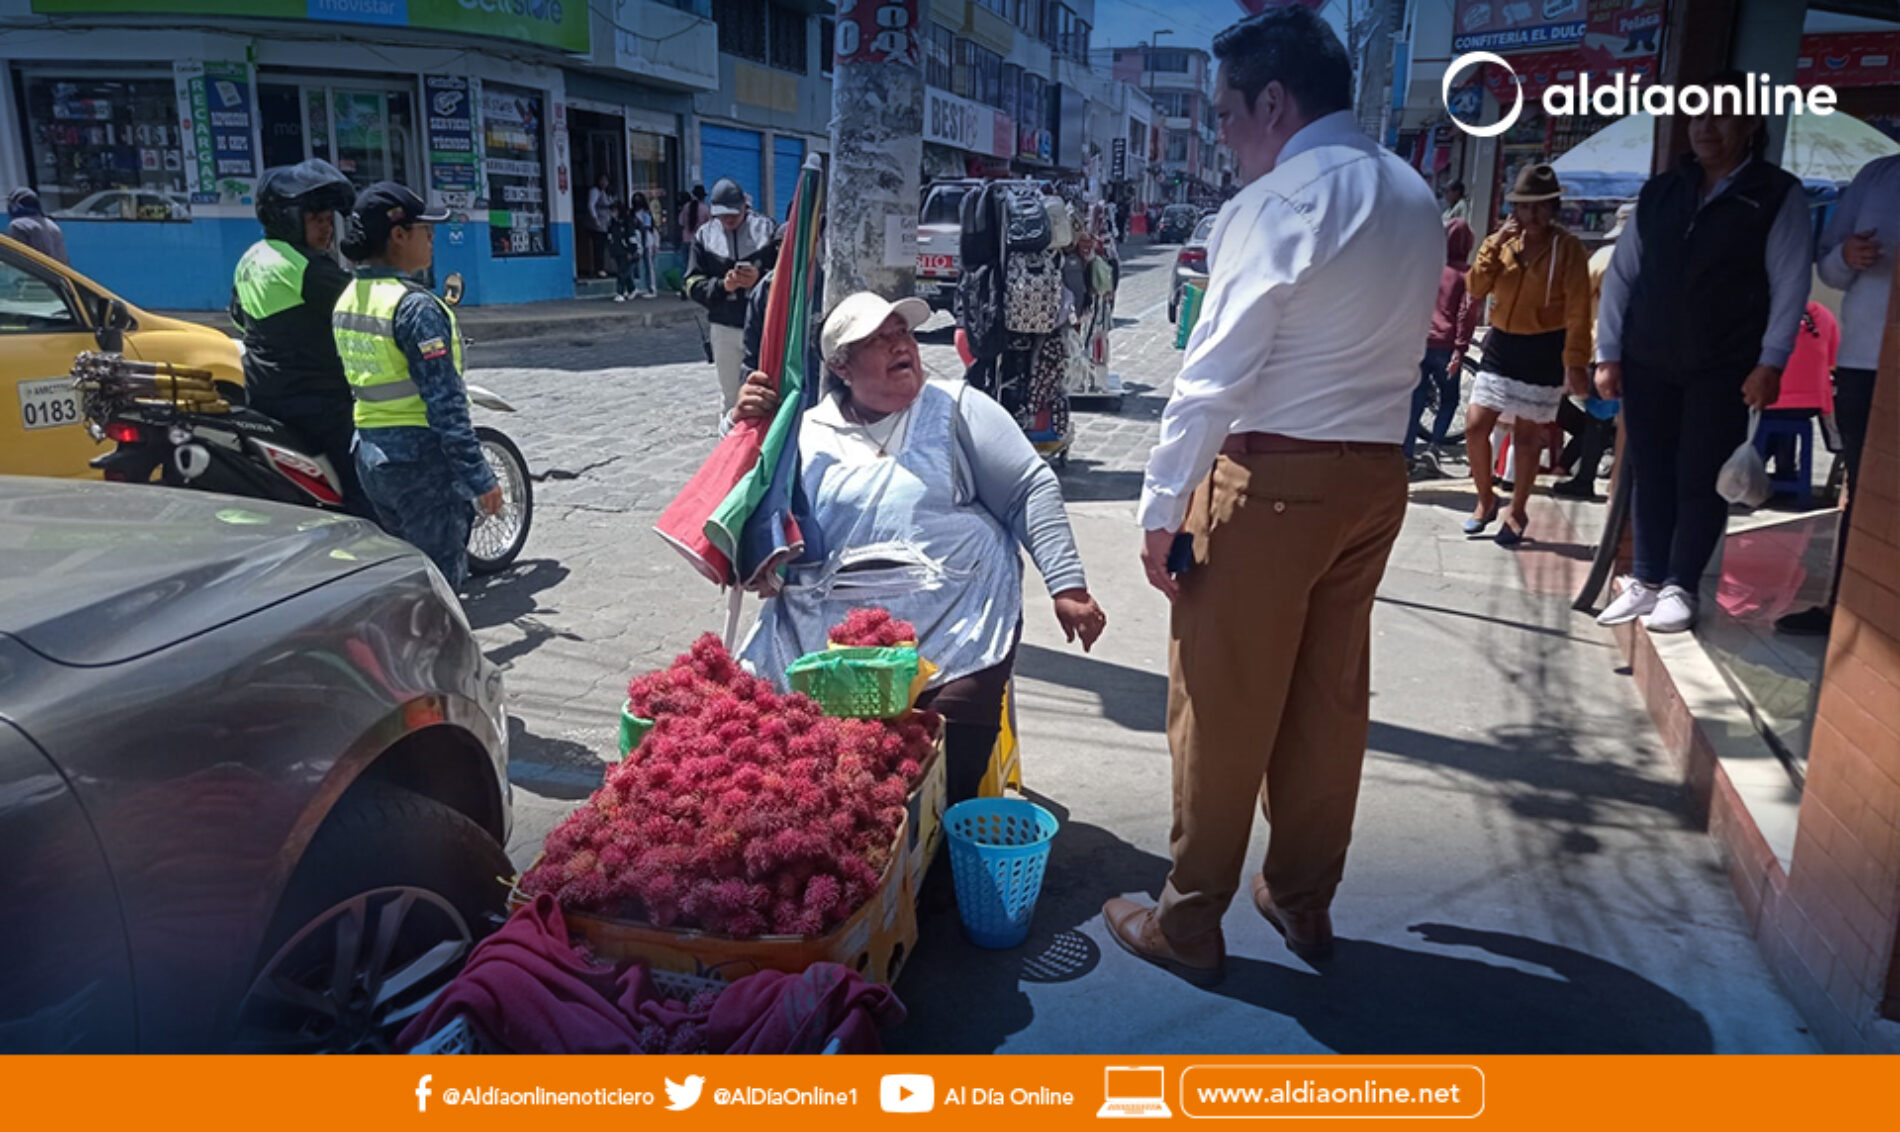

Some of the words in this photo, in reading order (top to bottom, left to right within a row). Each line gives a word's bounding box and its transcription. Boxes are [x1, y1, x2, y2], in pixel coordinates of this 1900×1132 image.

[1530, 28, 1547, 41] EL
[930, 95, 966, 144] BEST
[24, 398, 76, 426] 0183
